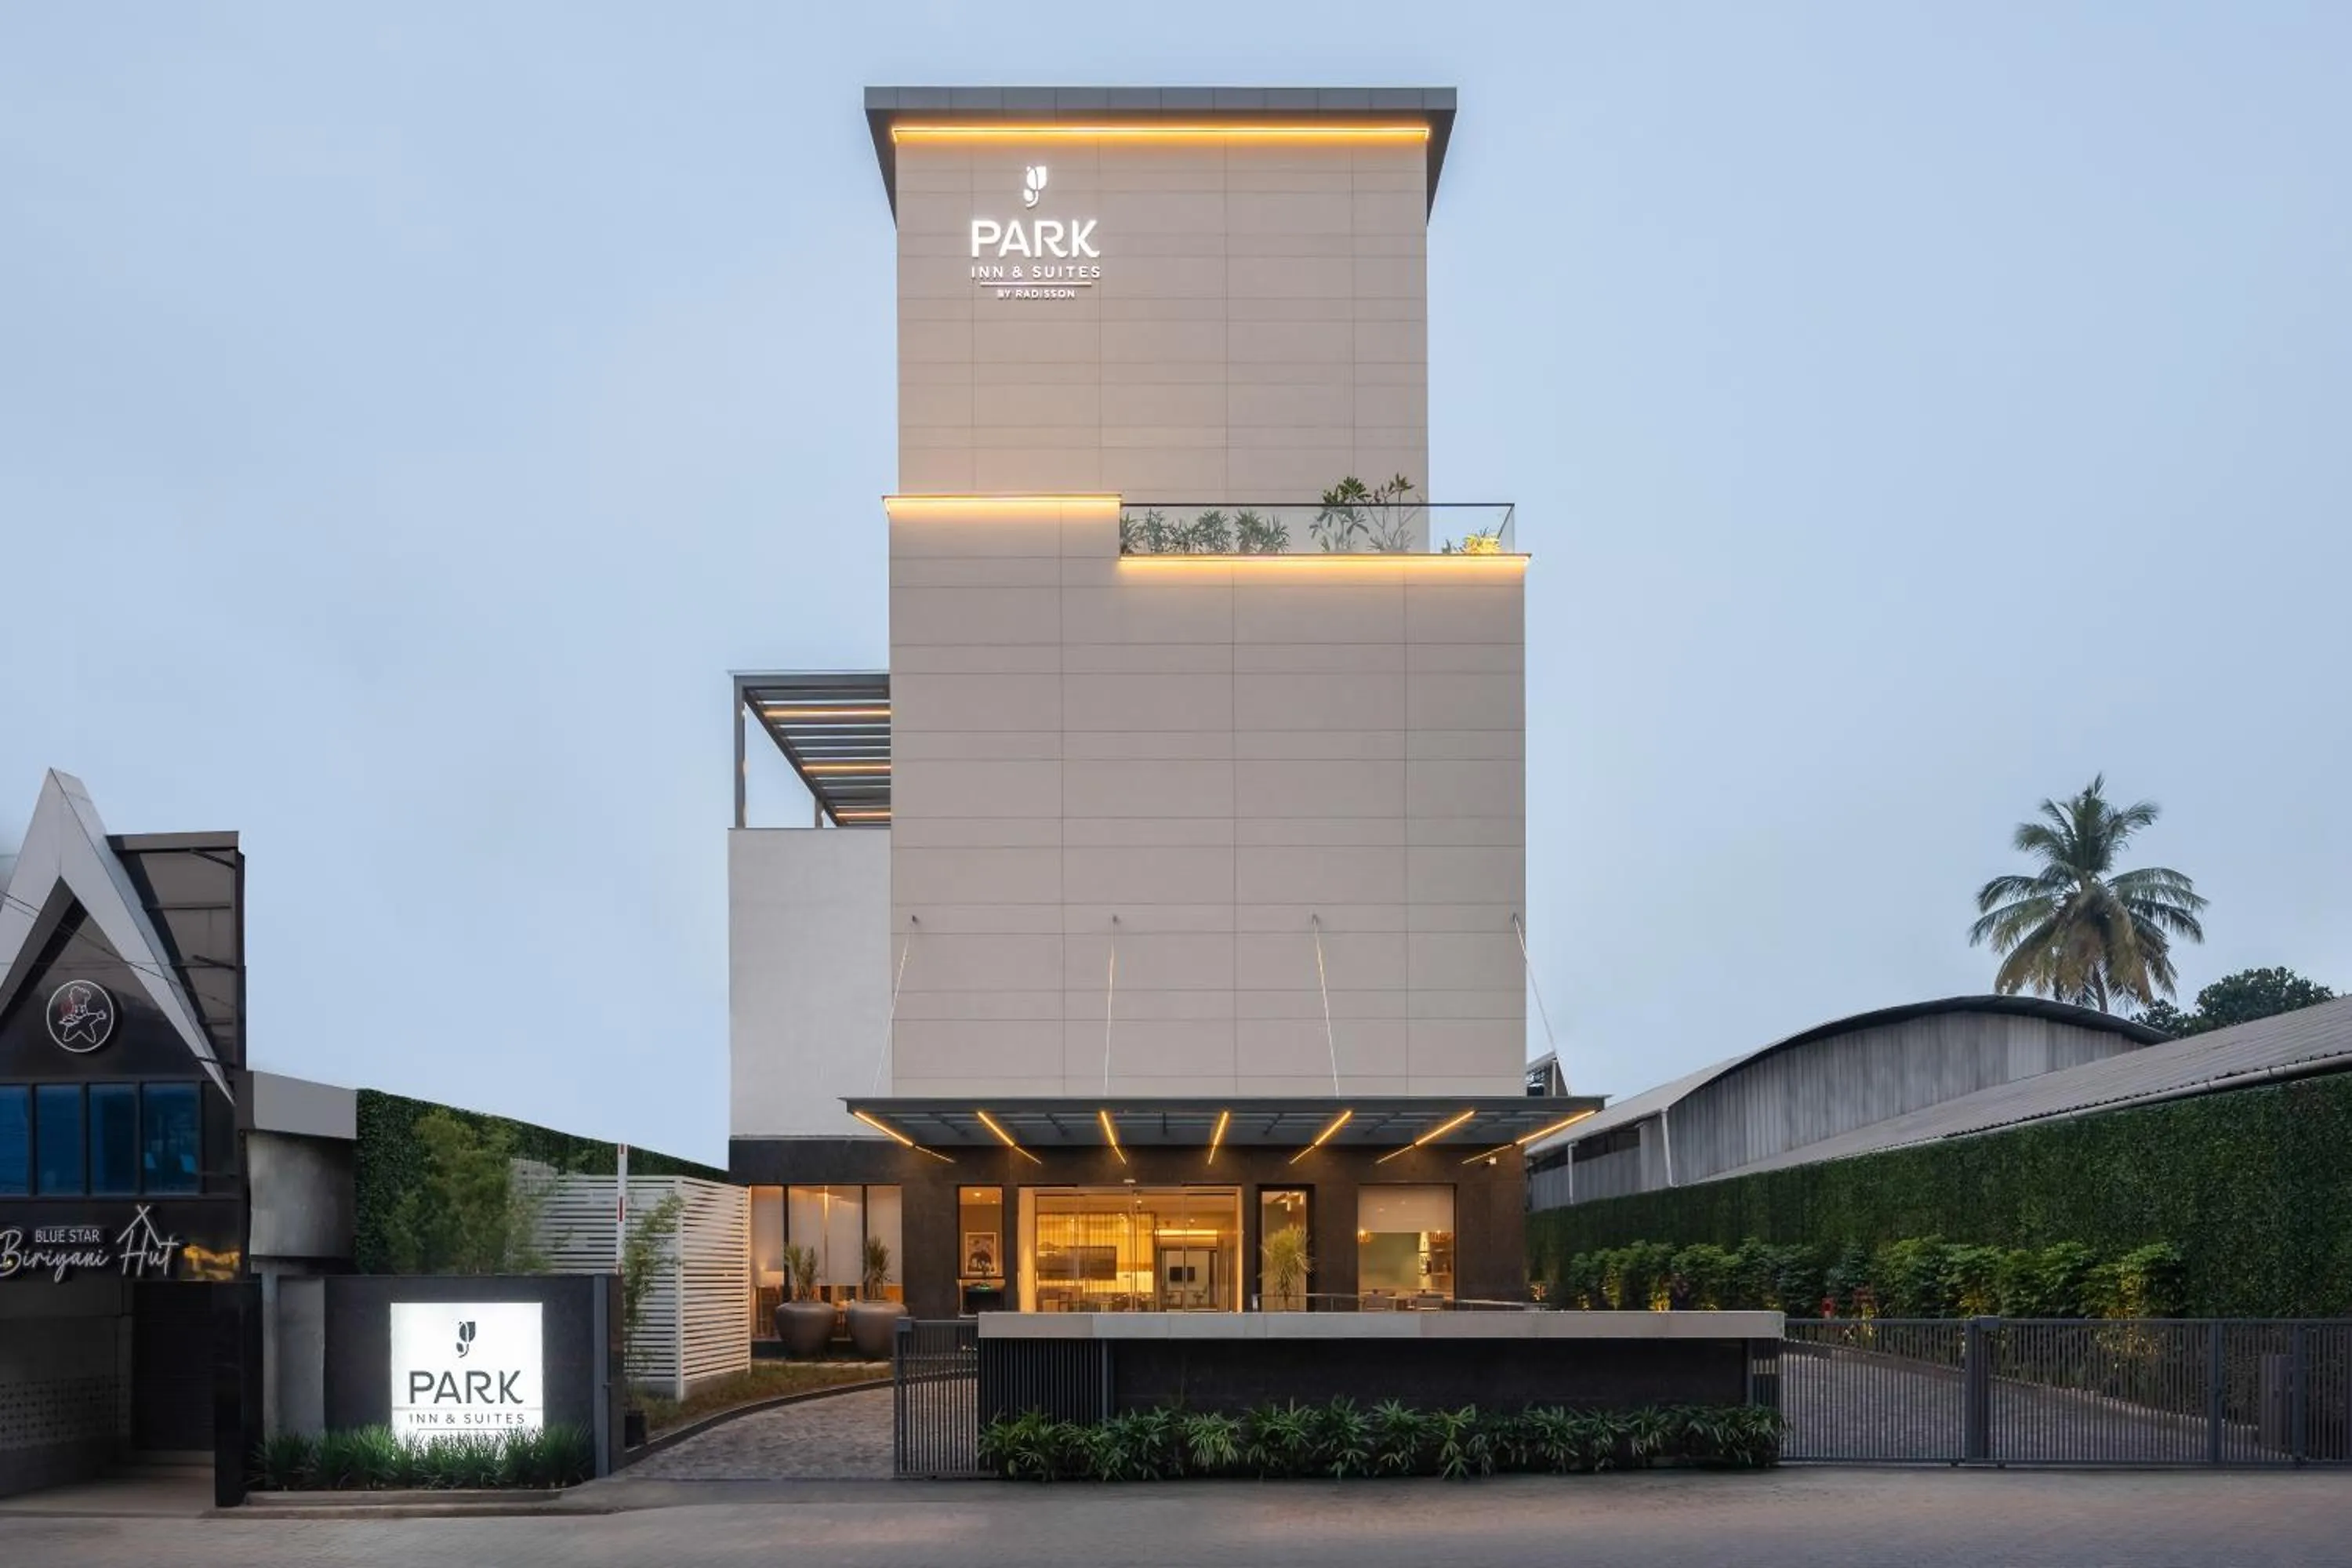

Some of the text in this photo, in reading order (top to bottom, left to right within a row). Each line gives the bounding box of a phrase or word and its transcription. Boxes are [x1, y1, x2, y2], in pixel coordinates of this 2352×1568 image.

[971, 220, 1101, 258] PARK
[971, 266, 1101, 278] INN & SUITES
[997, 289, 1075, 298] BY RADISSON
[35, 1229, 100, 1243] BLUE STAR
[117, 1204, 179, 1276] Hut
[409, 1370, 524, 1404] PARK
[409, 1413, 525, 1425] INN & SUITES
